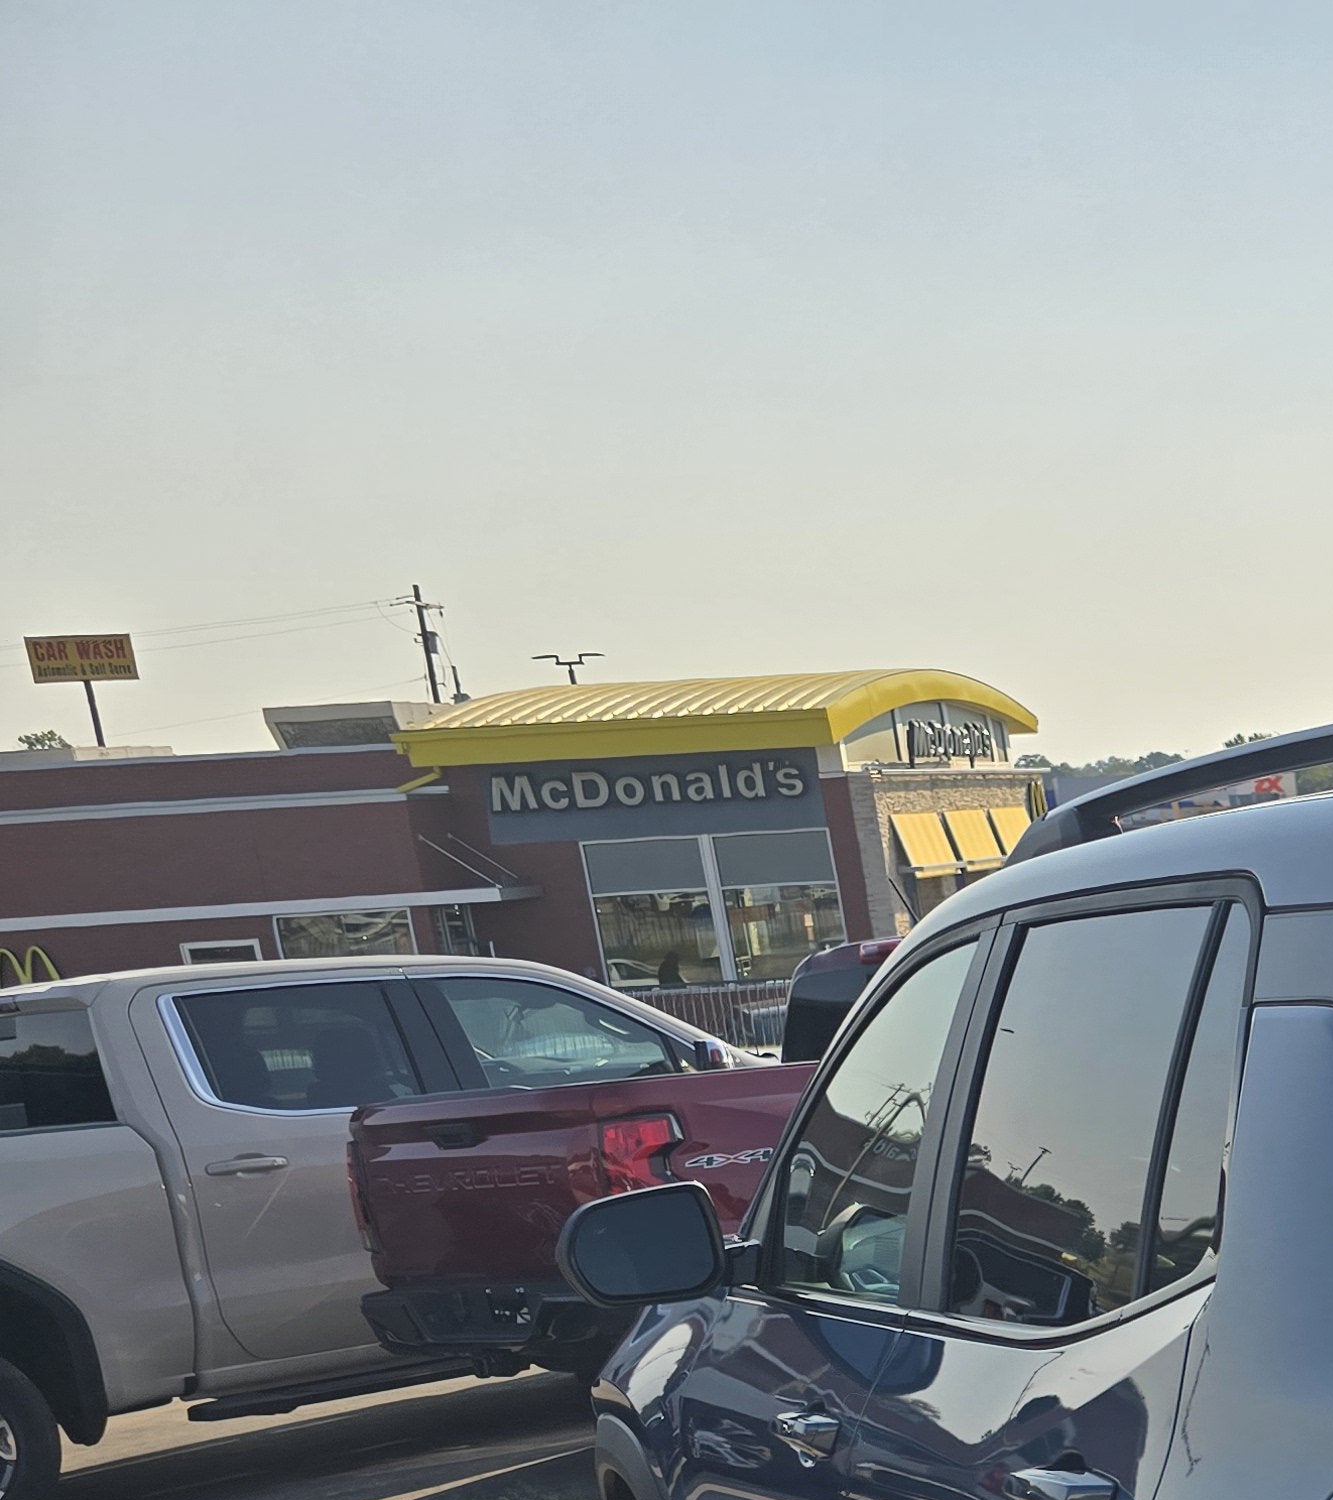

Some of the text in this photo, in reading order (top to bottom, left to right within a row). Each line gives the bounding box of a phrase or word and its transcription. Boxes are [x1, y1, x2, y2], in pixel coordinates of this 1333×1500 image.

[32, 639, 127, 662] CAR WASH
[491, 761, 804, 812] McDonald's
